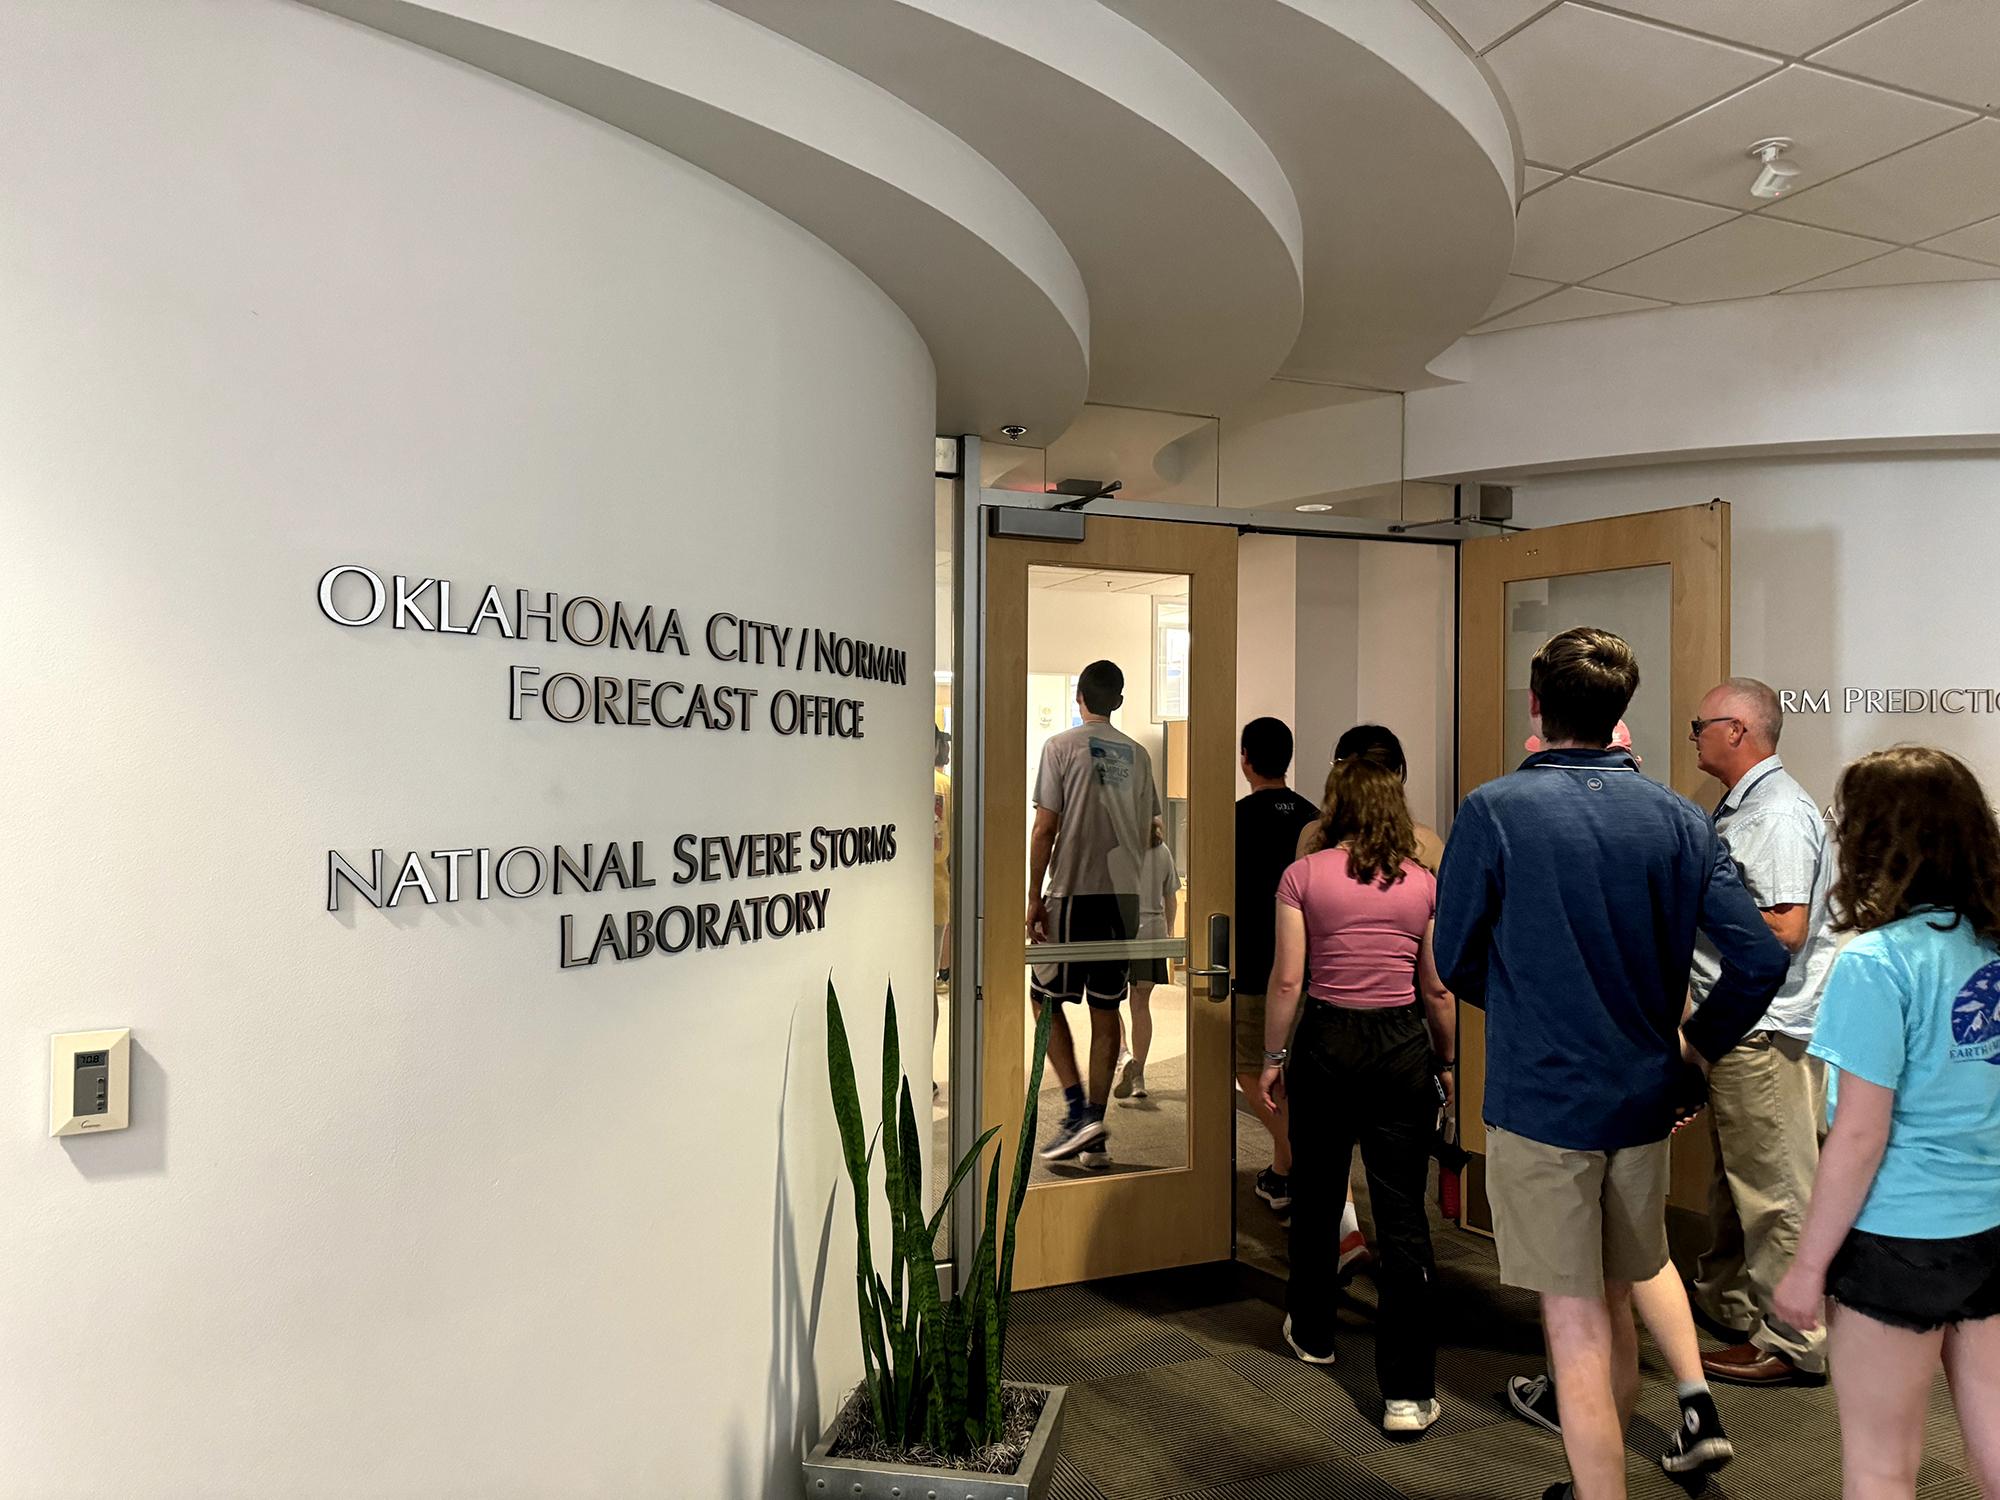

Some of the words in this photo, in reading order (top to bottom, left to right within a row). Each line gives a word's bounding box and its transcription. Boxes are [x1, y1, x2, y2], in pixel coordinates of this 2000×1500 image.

[318, 564, 690, 656] OKLAHOMA
[509, 665, 758, 732] FORECAST
[770, 689, 865, 738] OFFICE
[327, 841, 656, 911] NATIONAL
[672, 831, 802, 885] SEVERE
[809, 824, 898, 870] STORMS
[560, 888, 831, 968] LABORATORY
